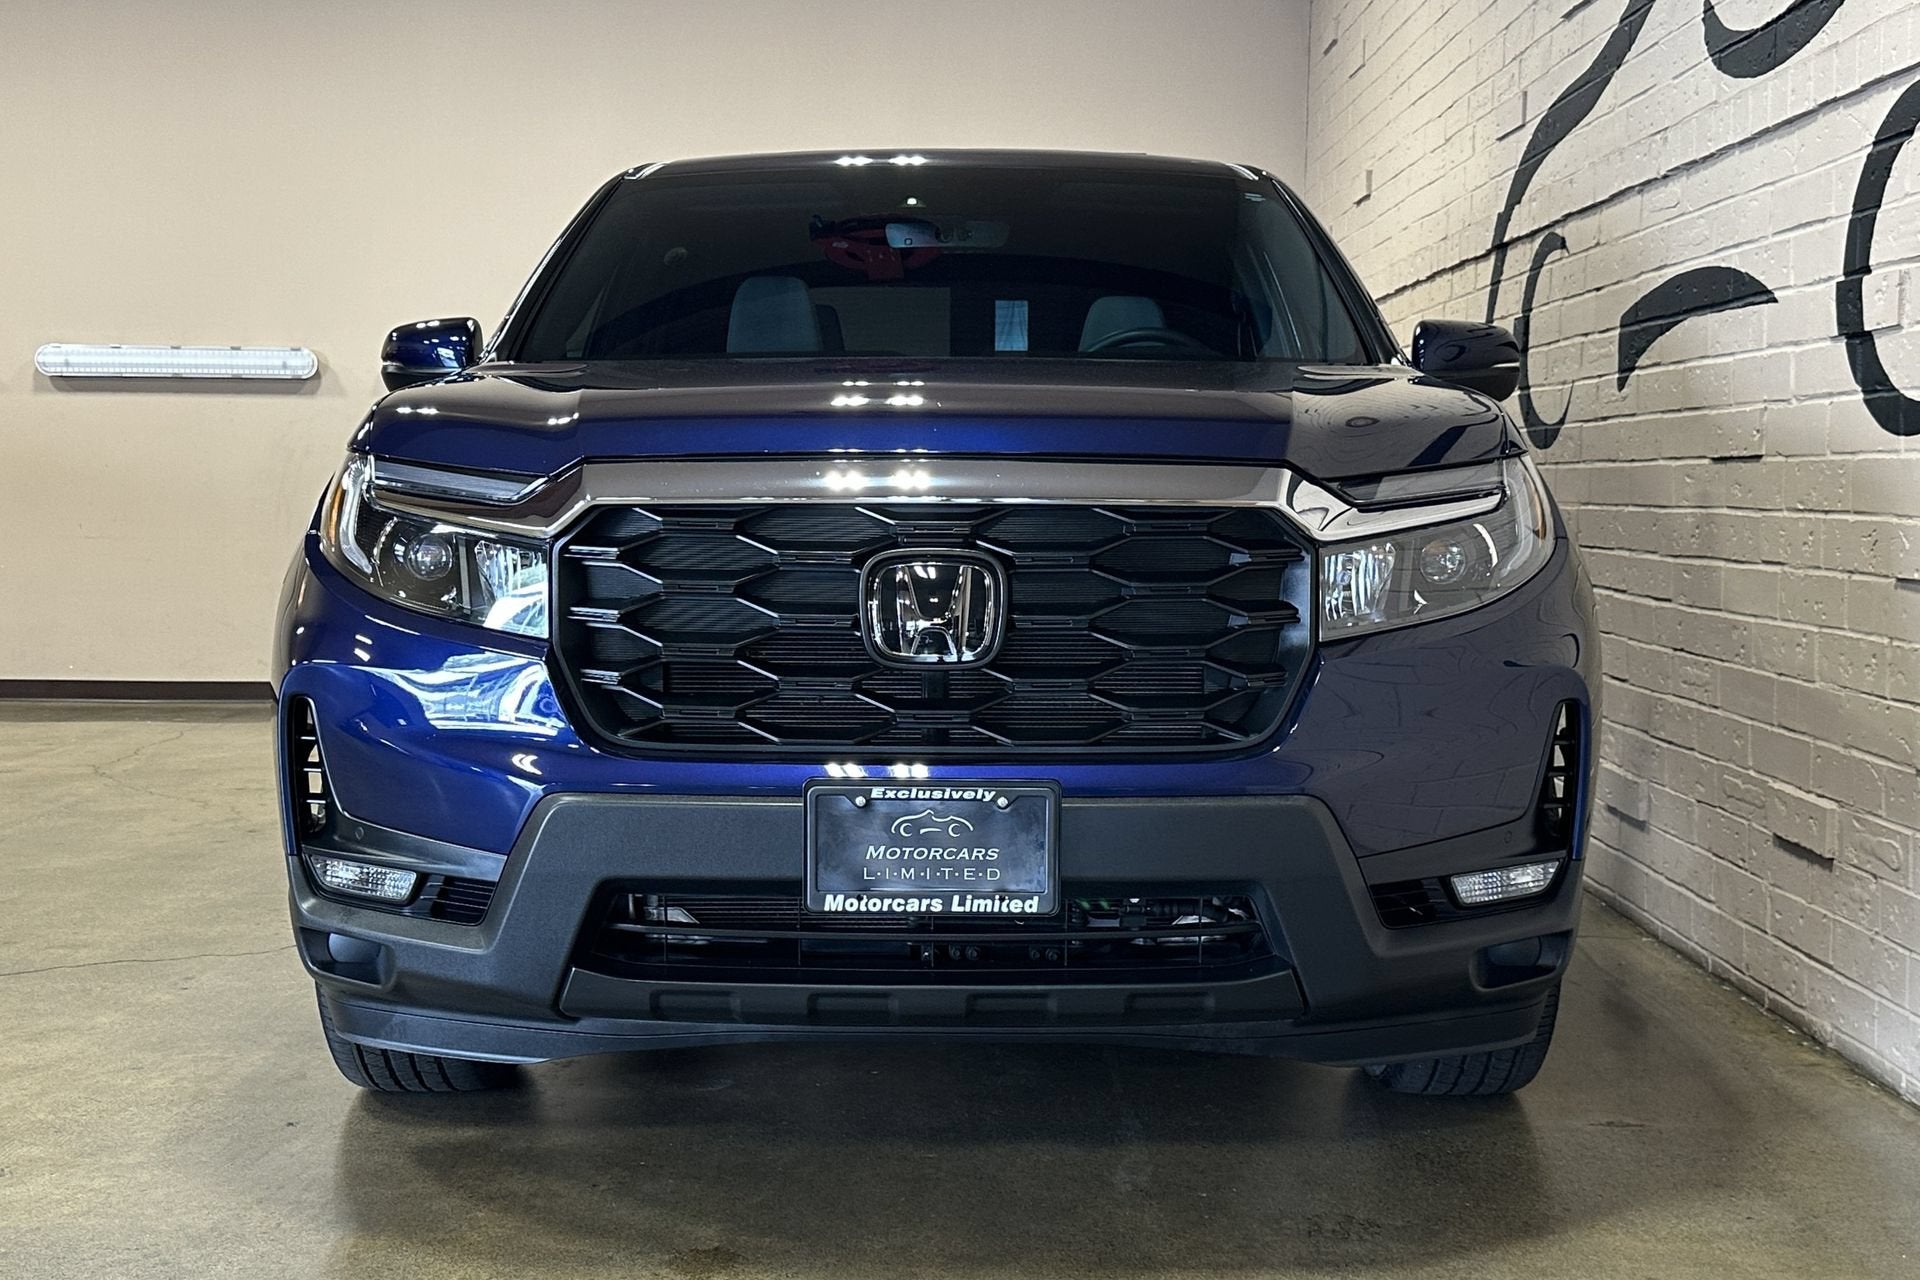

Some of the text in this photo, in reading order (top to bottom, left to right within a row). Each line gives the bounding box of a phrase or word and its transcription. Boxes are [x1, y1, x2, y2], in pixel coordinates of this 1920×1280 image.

[871, 787, 996, 801] Exclusively
[865, 845, 1000, 860] MOTORCARS
[824, 894, 1039, 913] Motorcars Limited
